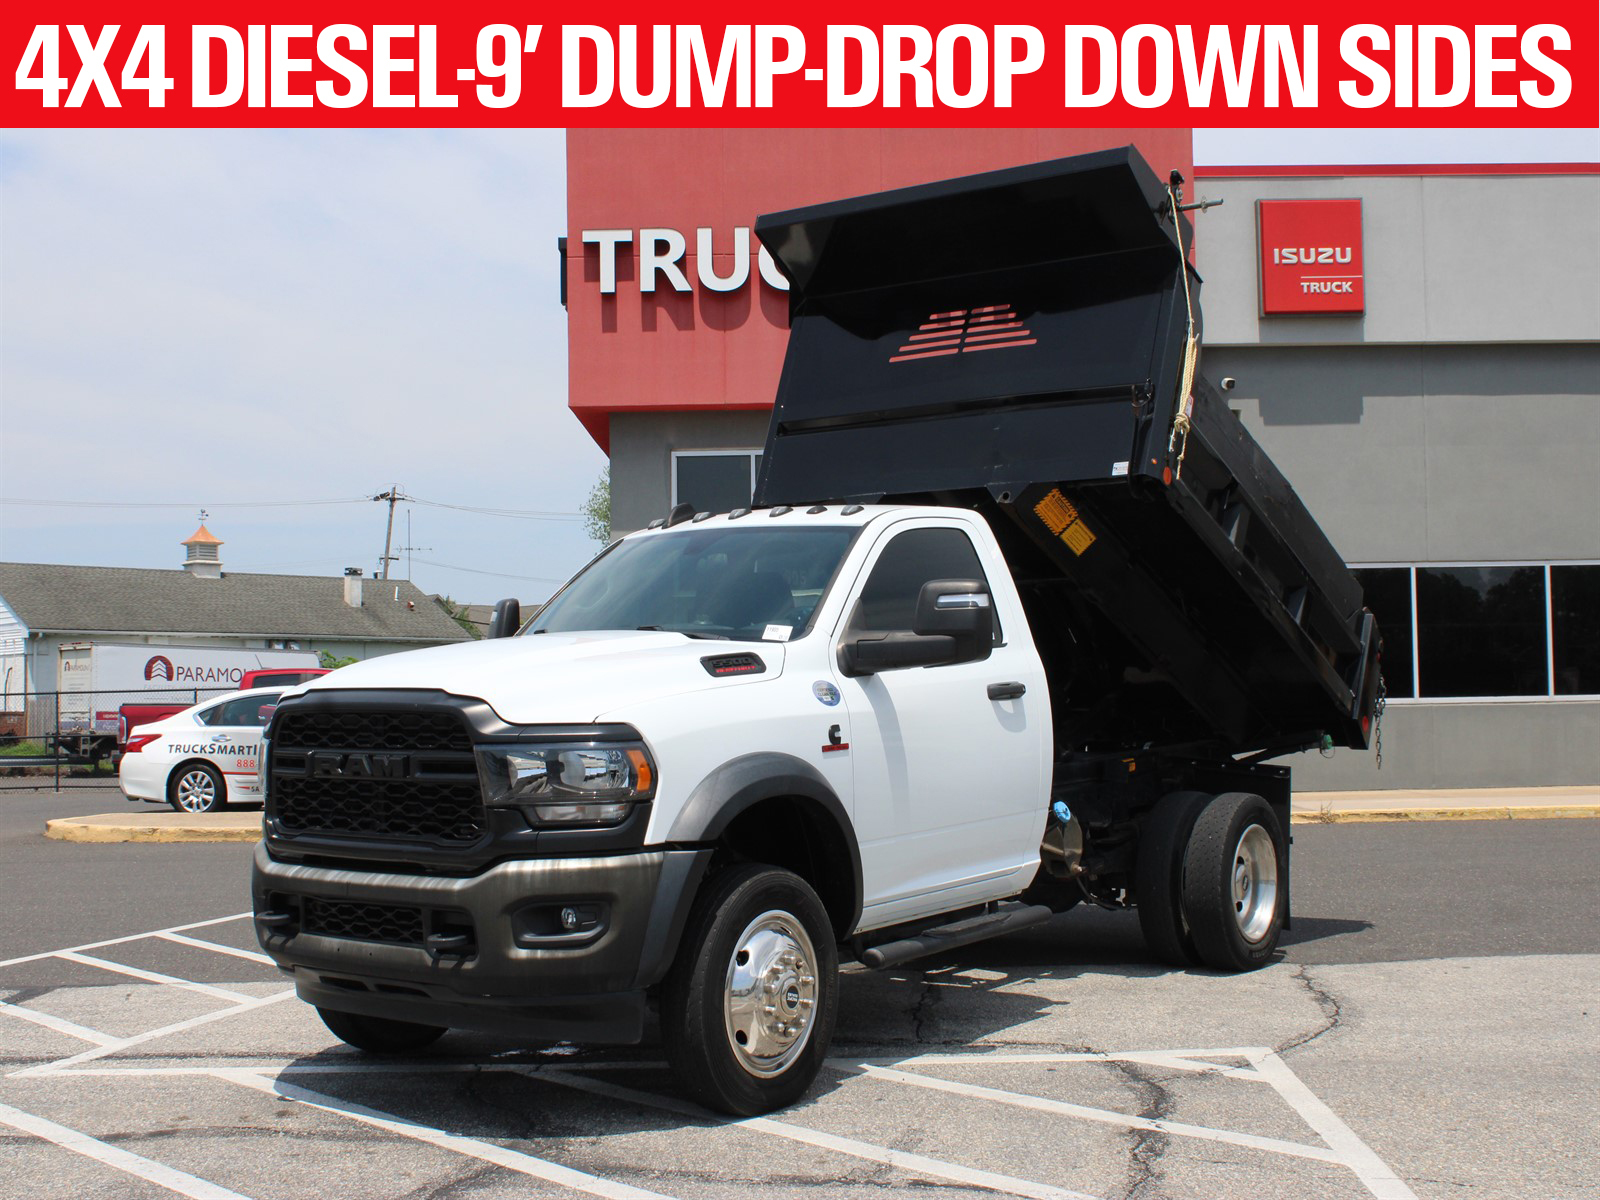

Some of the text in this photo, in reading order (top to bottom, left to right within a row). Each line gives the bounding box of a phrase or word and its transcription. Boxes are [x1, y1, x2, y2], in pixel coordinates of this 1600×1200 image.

[1273, 247, 1352, 264] ISUZU
[1300, 281, 1353, 294] TRUCK
[176, 666, 247, 683] PARAMO
[313, 753, 409, 778] RAM
